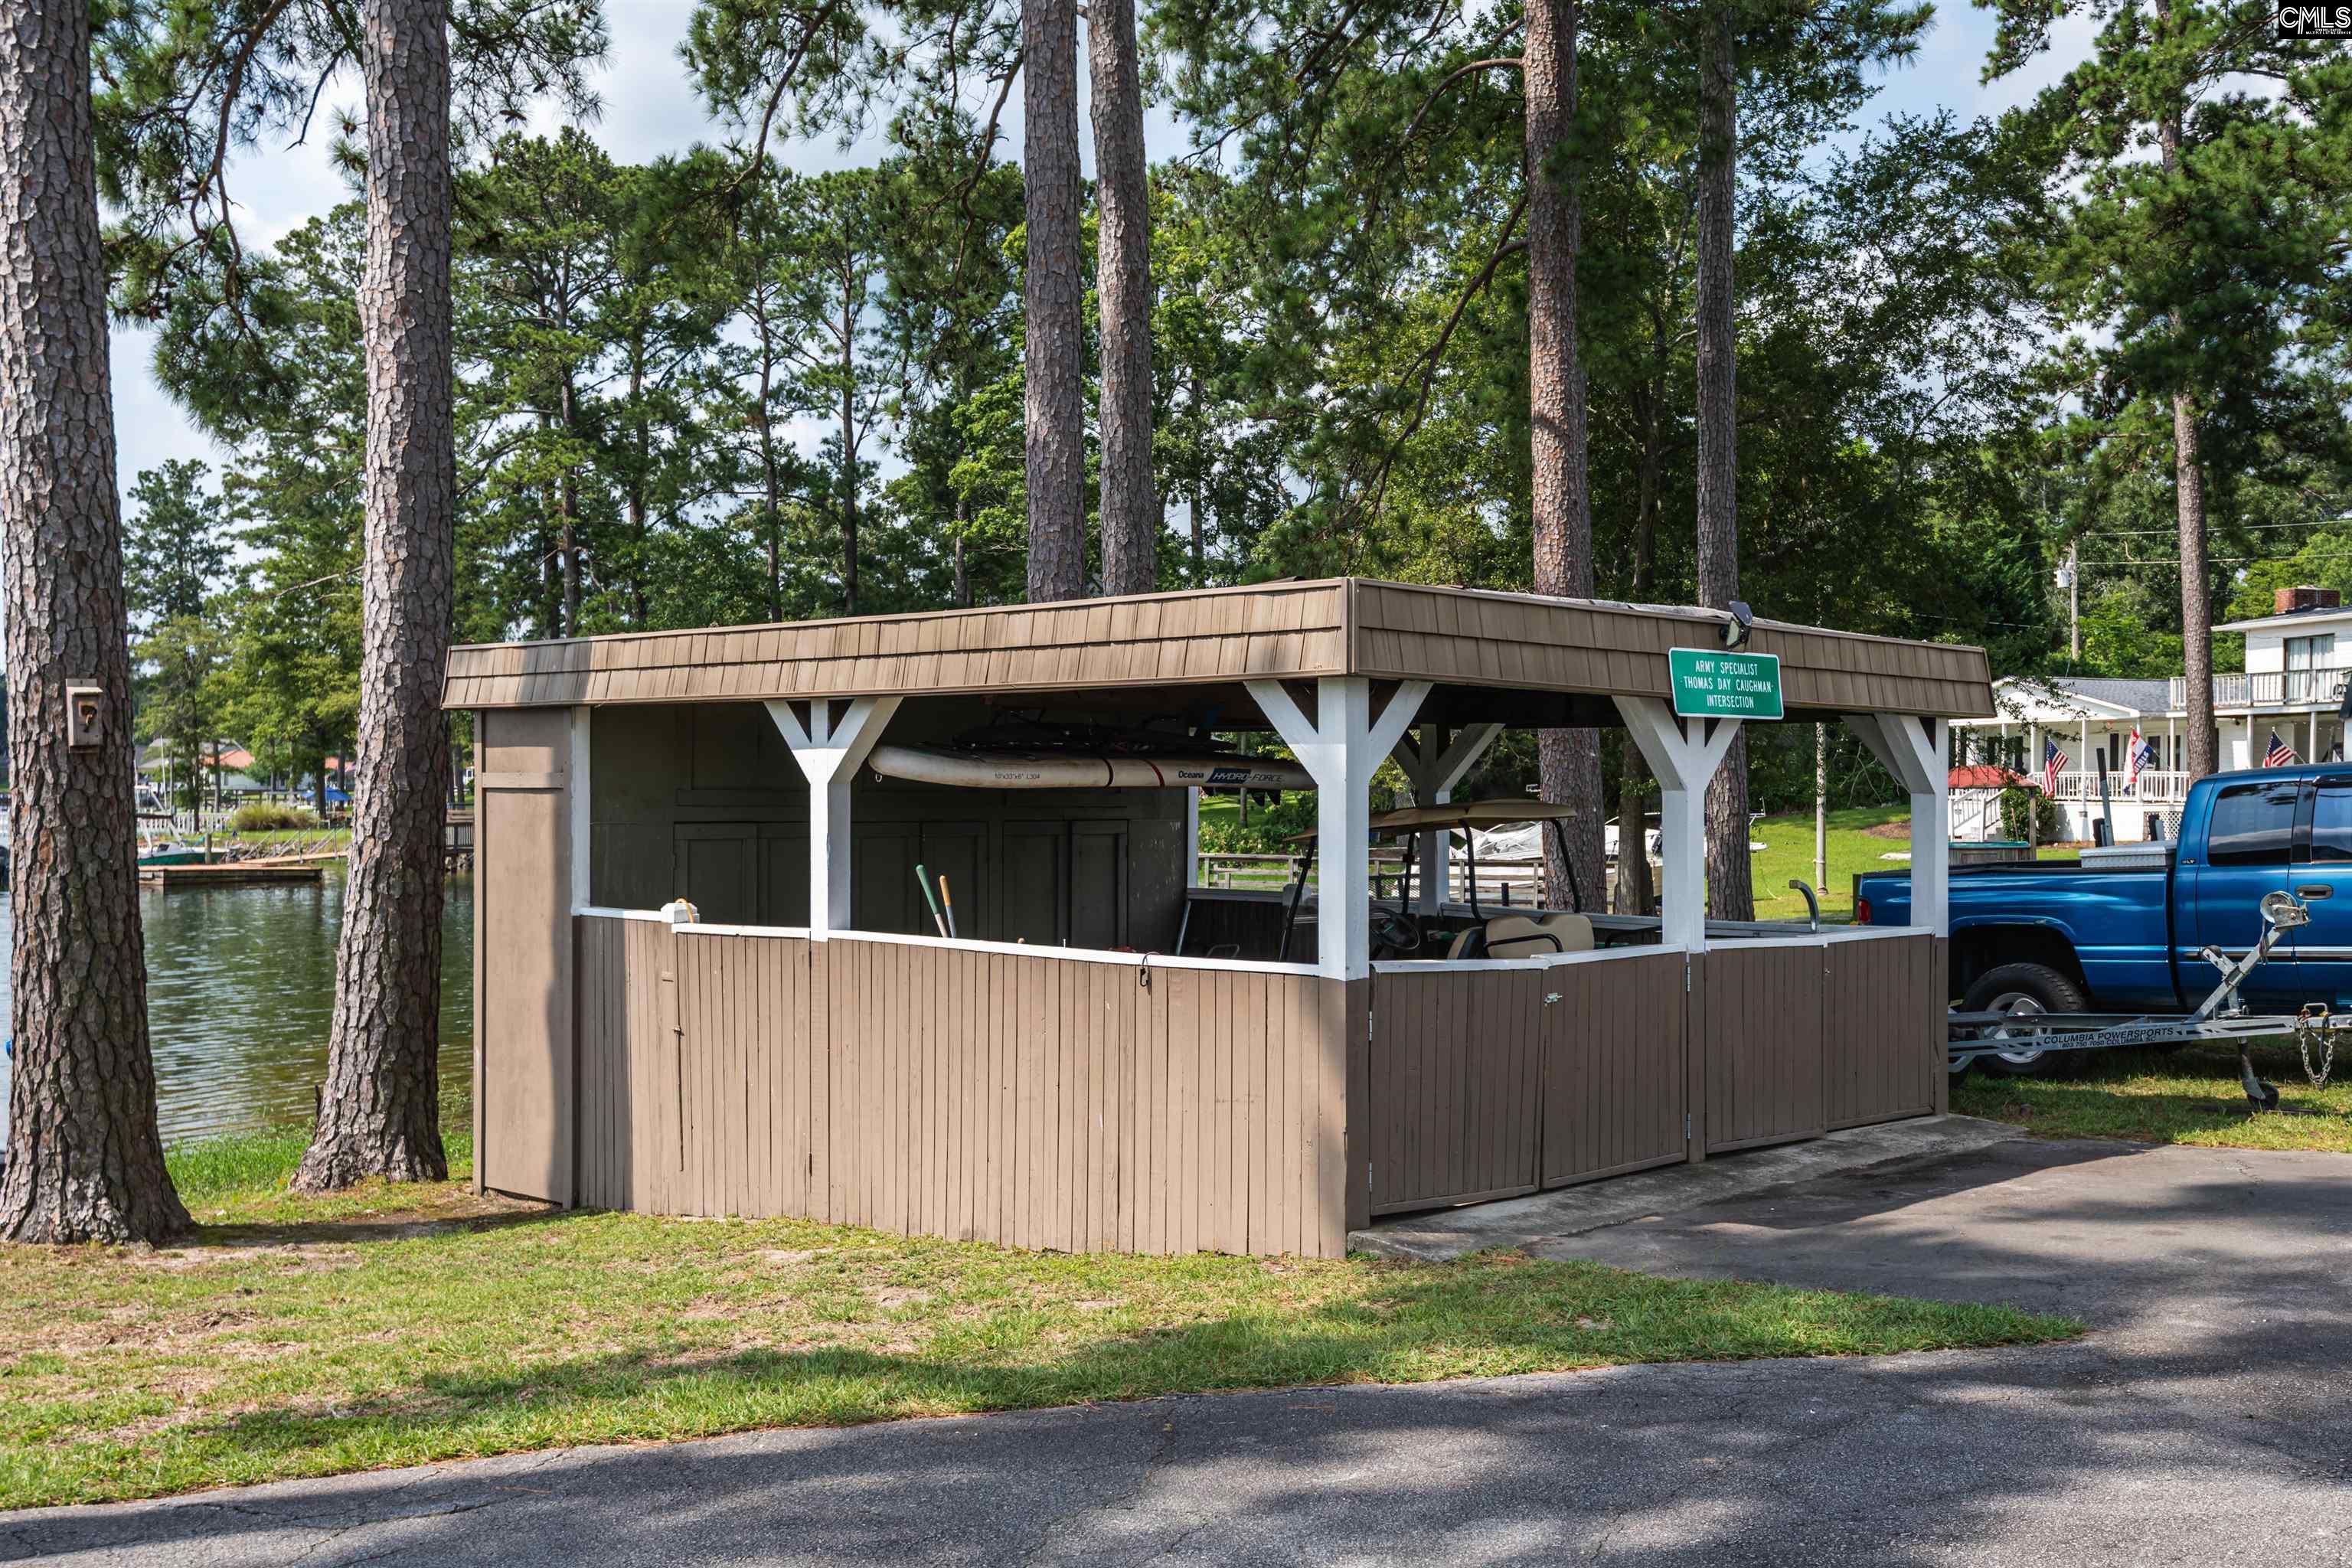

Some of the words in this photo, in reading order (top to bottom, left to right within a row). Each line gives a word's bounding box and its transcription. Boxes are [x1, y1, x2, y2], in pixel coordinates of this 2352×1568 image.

[1695, 660, 1715, 673] ARMY
[1720, 662, 1758, 675] SPECIALIST
[1684, 676, 1713, 690] THOMAS
[1717, 678, 1731, 691] DAY
[1736, 679, 1772, 693] CAUGHMAN
[1707, 694, 1754, 708] INTERSECTION
[1178, 769, 1204, 779] Oceana
[1212, 771, 1284, 782] HYDRO-FORCE
[2044, 1034, 2095, 1044] COLUMBIA
[2097, 1027, 2174, 1040] POWERSPORTS
